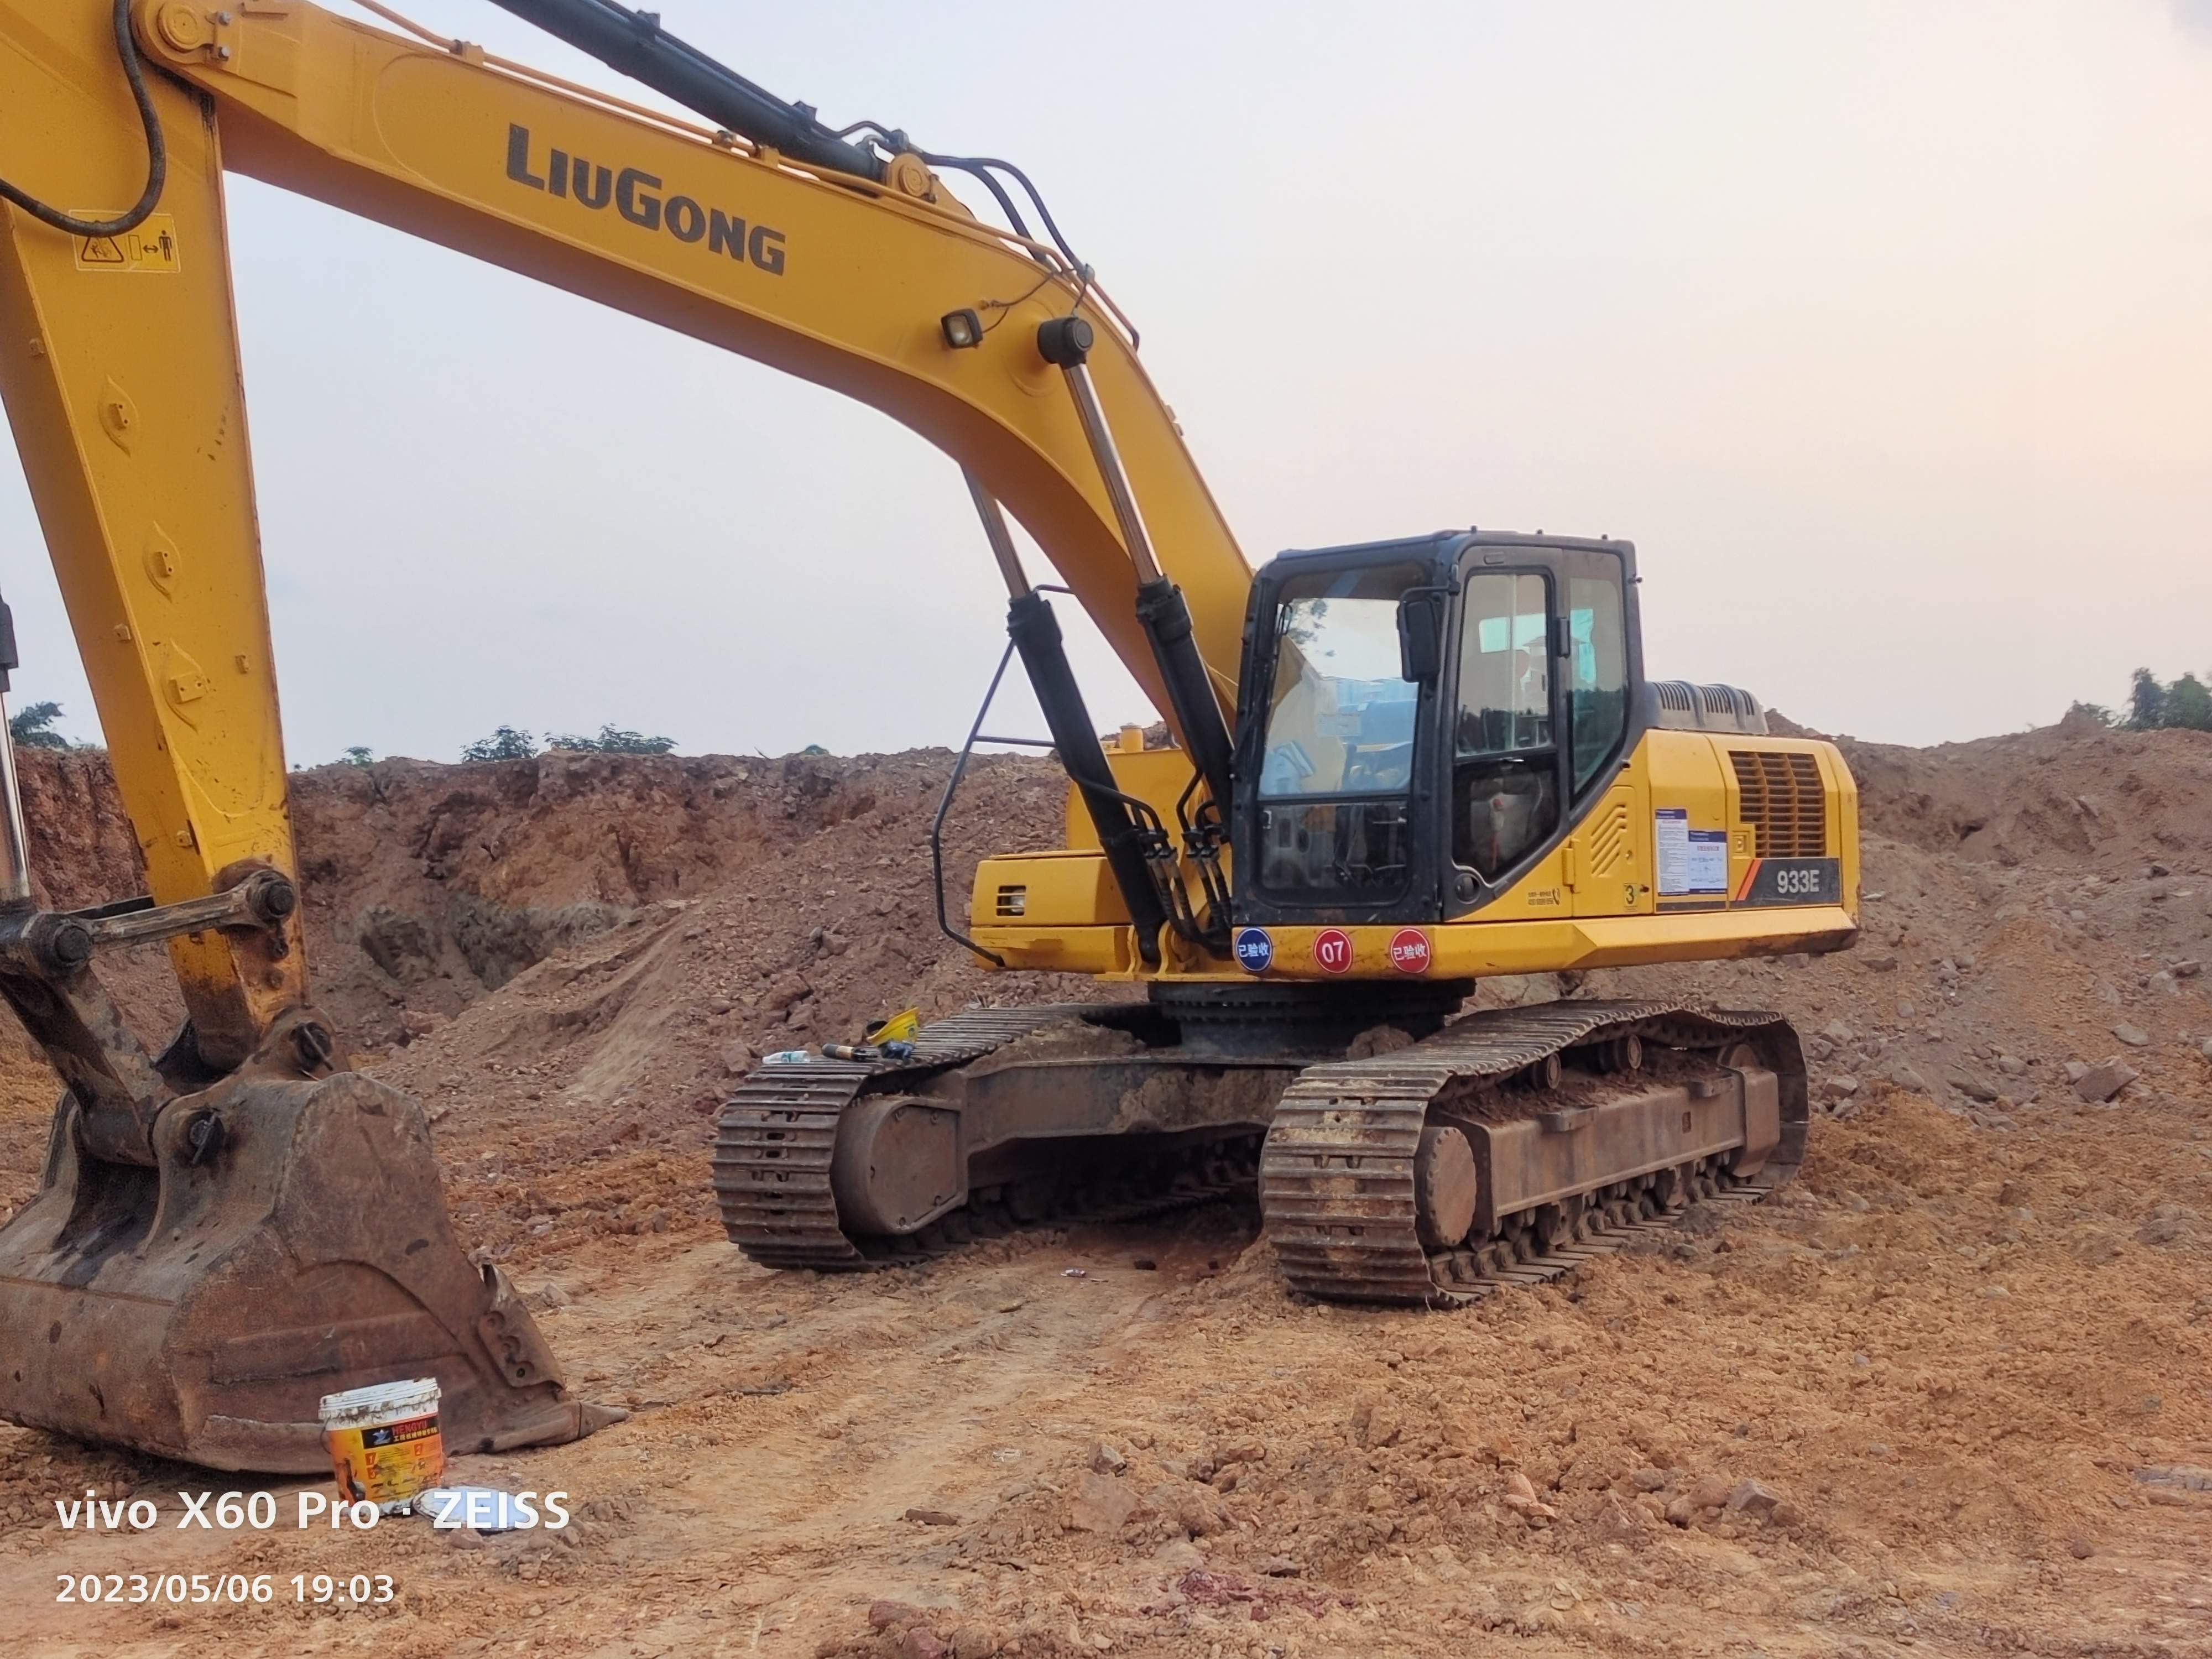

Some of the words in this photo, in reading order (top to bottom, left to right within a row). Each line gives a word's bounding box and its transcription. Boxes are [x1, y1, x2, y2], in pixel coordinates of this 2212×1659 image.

[1777, 869, 1820, 894] 933E
[1625, 884, 1635, 905] 3
[1238, 942, 1269, 958] 已验收
[1321, 941, 1344, 963] 07
[1392, 944, 1427, 961] 已验收
[392, 1421, 427, 1436] HENGYU
